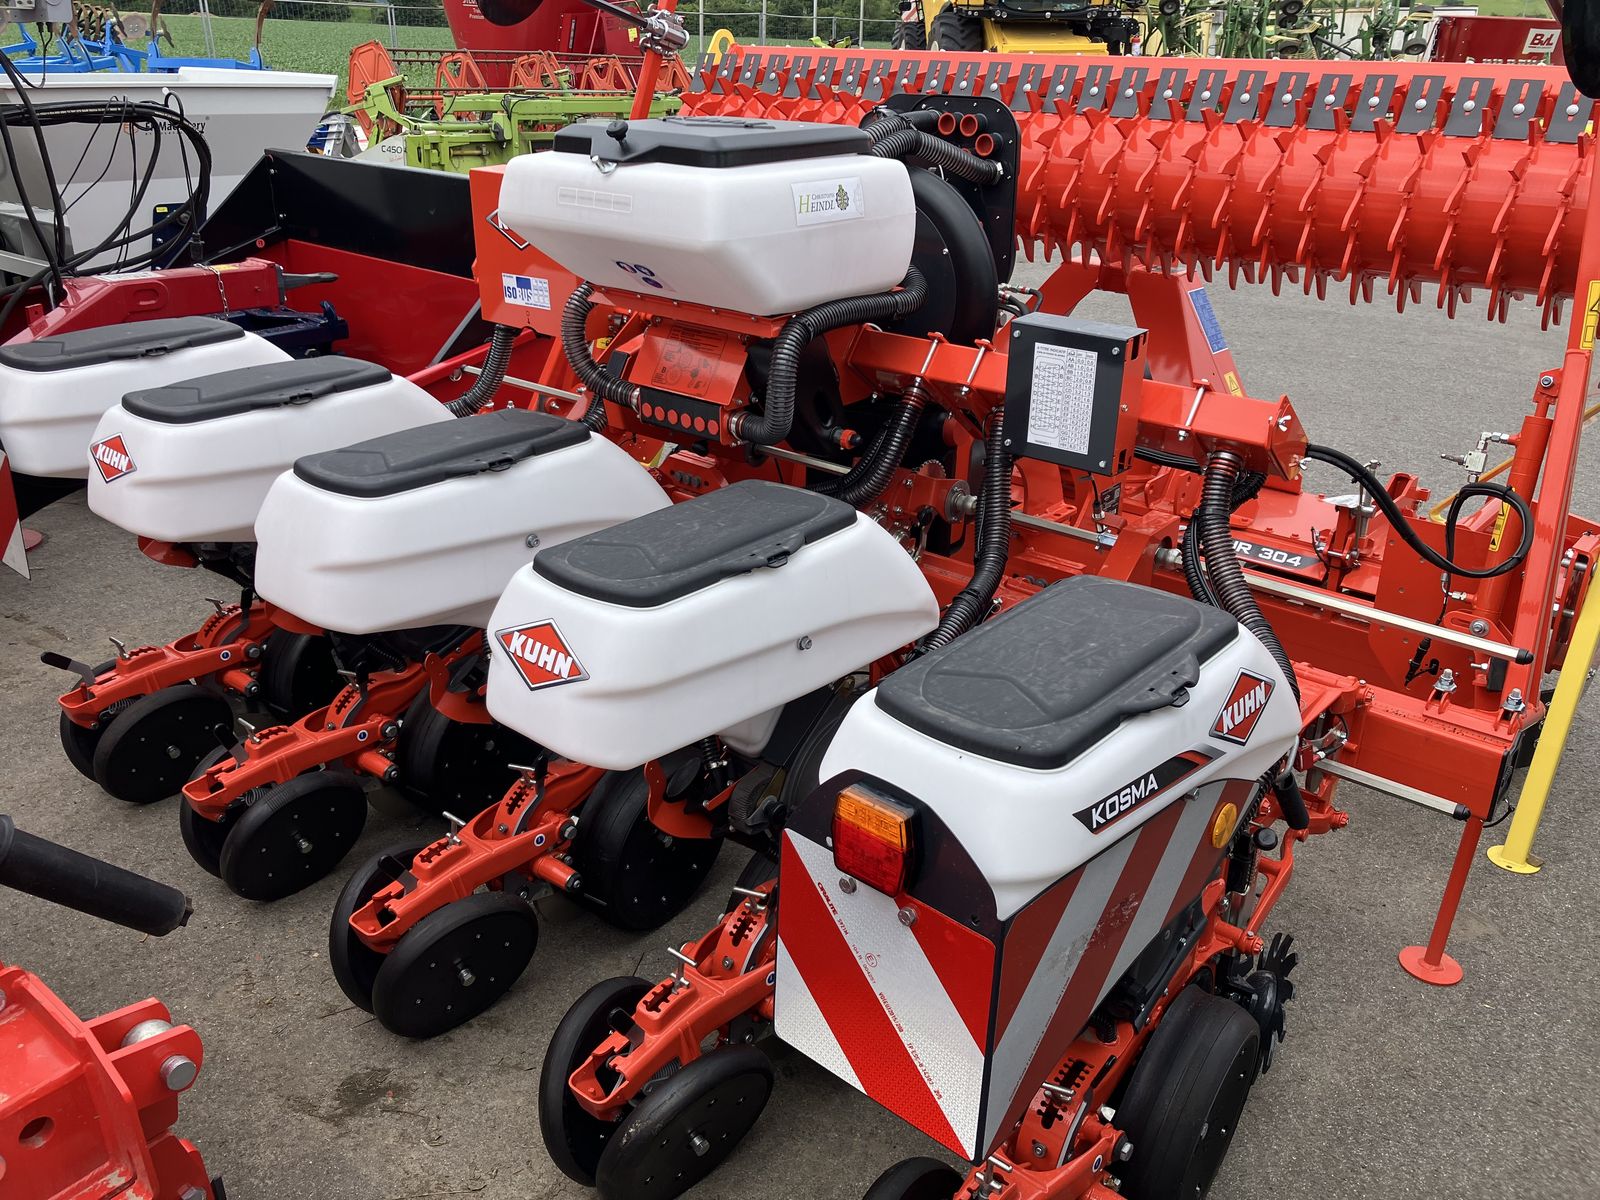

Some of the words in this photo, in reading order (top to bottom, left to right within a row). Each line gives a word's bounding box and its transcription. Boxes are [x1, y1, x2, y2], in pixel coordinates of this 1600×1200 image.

[381, 145, 403, 154] C450
[96, 443, 130, 472] KUHN
[1258, 547, 1302, 567] 304
[509, 631, 573, 679] KUHN
[1222, 681, 1267, 735] KUHN
[1091, 773, 1159, 829] KOSMA
